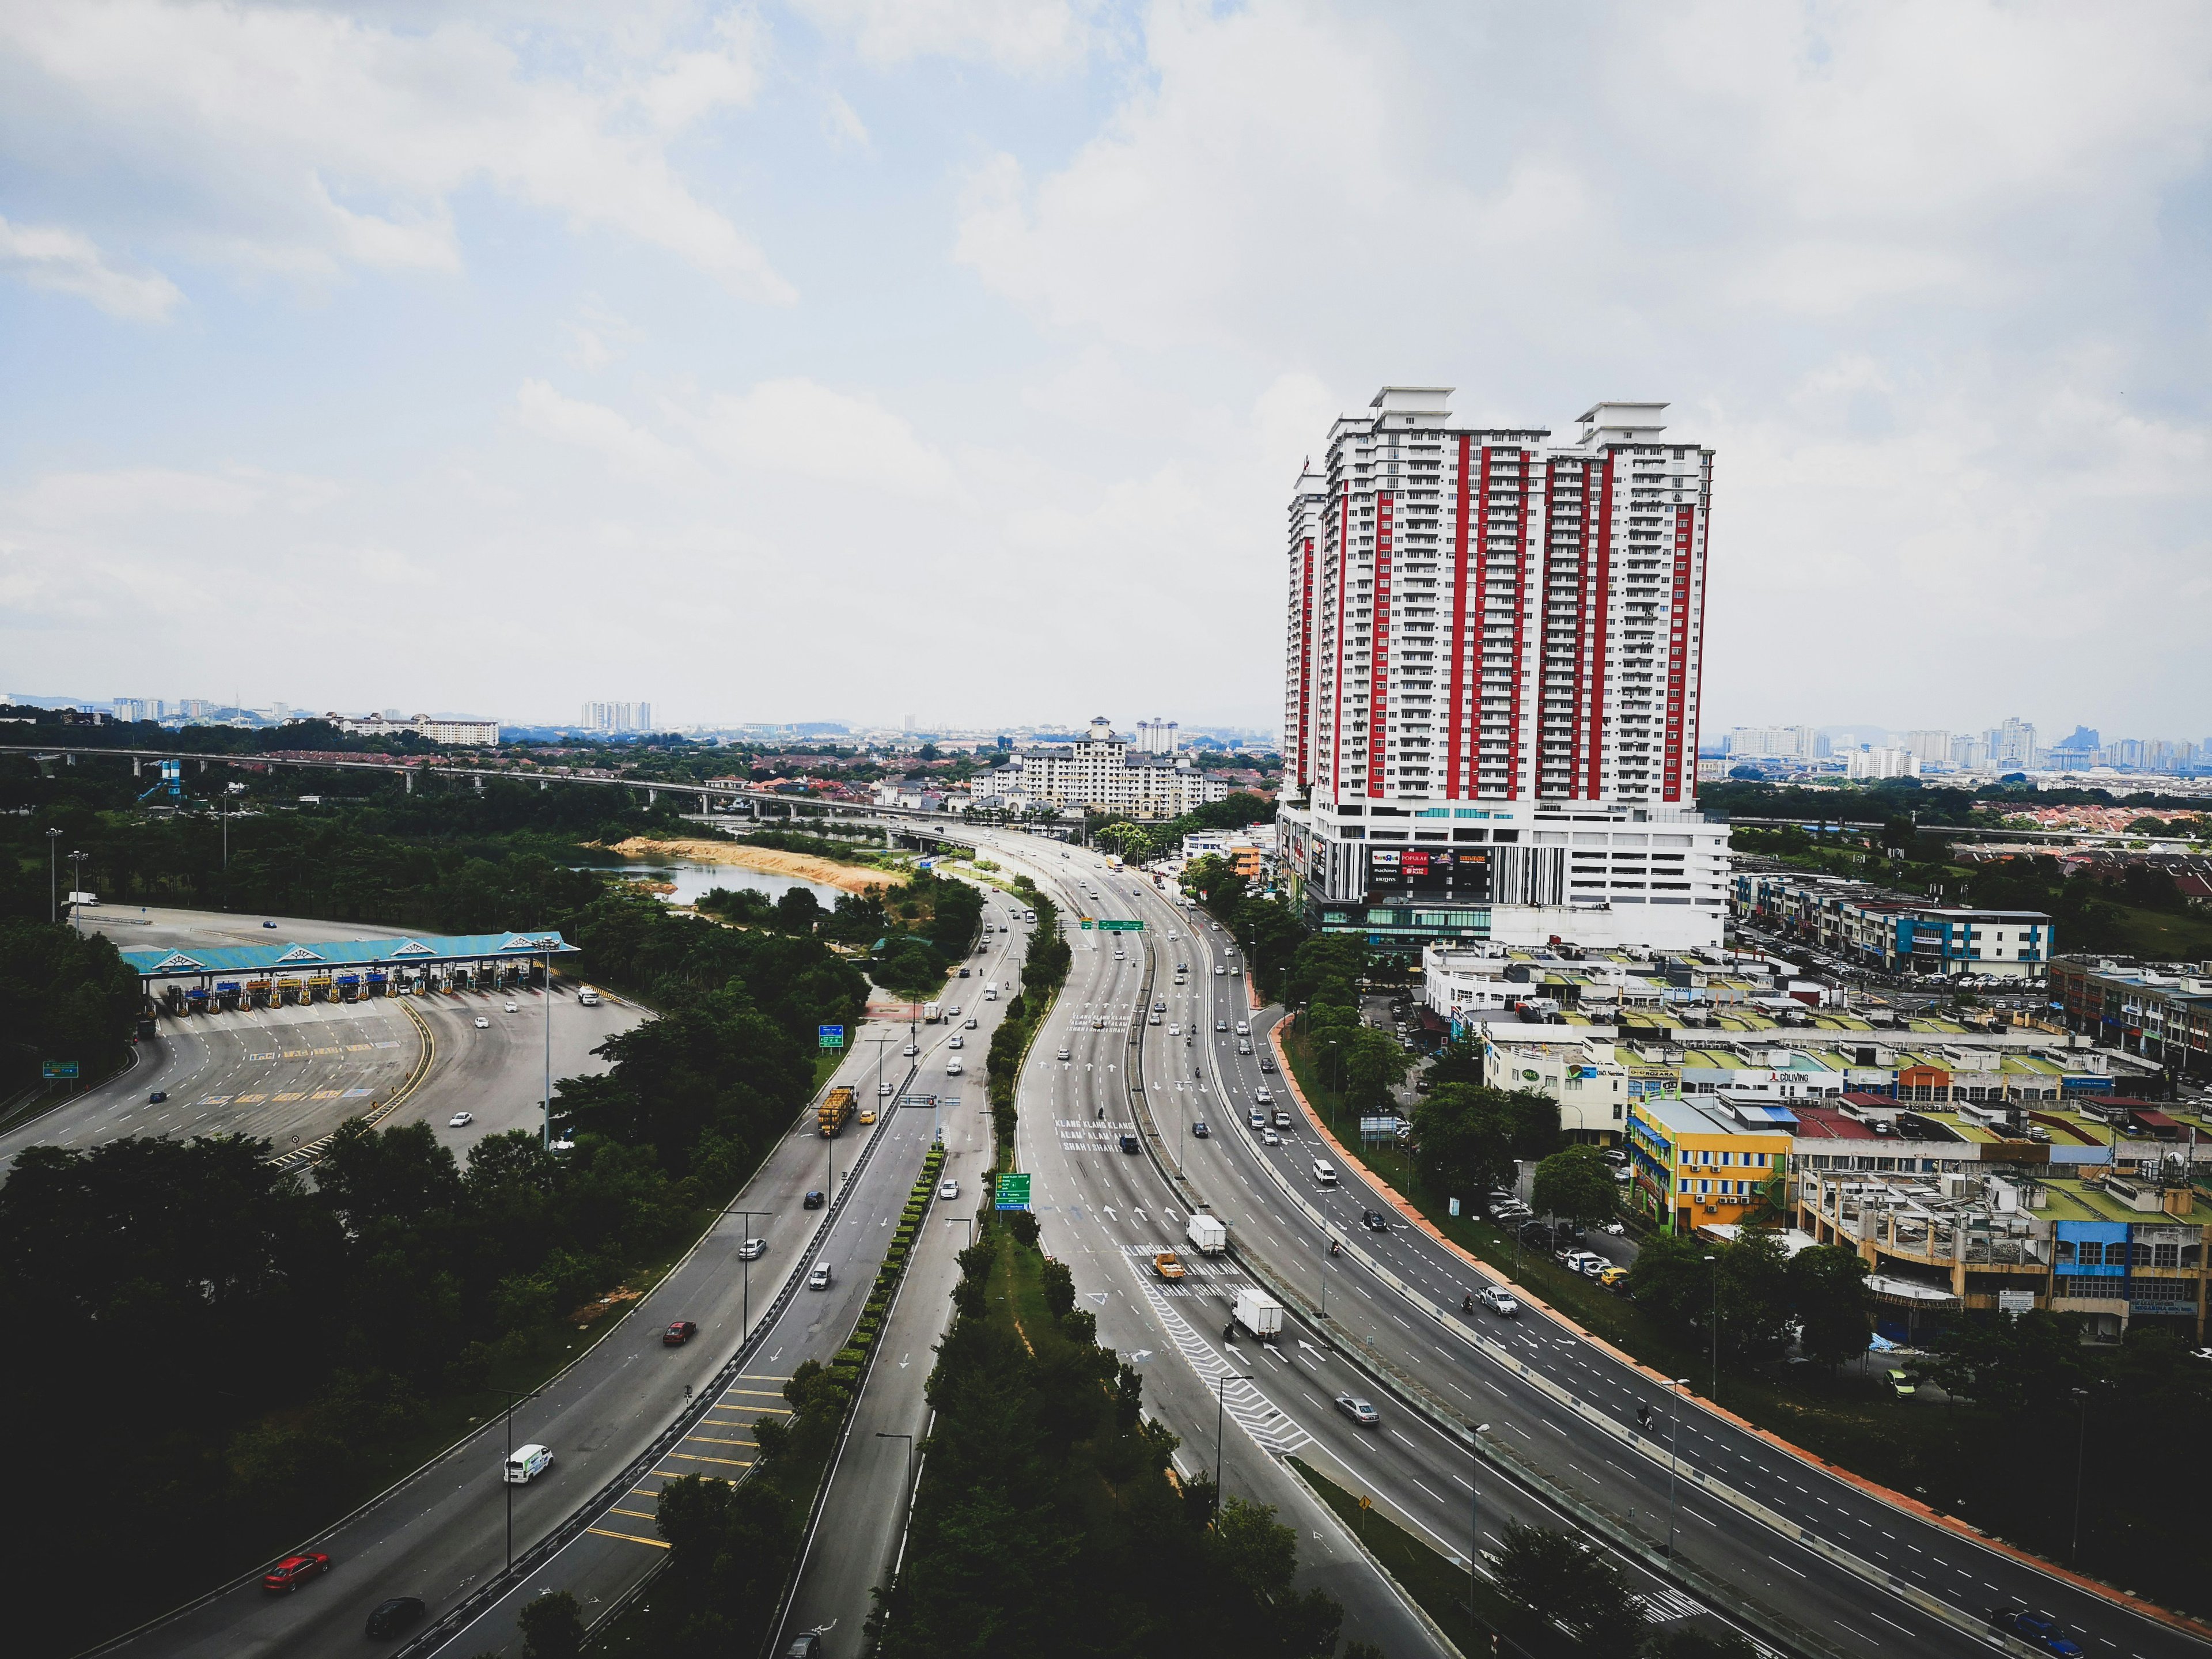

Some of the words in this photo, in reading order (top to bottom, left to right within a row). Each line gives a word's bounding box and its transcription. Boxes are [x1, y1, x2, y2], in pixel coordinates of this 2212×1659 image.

[1055, 1119, 1081, 1127] KLANG
[1083, 1120, 1107, 1129] KLANG
[1108, 1122, 1134, 1130] KLANG
[1060, 1131, 1083, 1139] ALAM
[1088, 1132, 1110, 1140] ALAM
[1063, 1142, 1086, 1151] SHAH
[1092, 1143, 1115, 1152] SHAH
[1120, 1245, 1156, 1256] KLANG
[1206, 1263, 1240, 1275] ALAM
[1156, 1283, 1192, 1297] SHAH
[1191, 1283, 1226, 1297] SHAH
